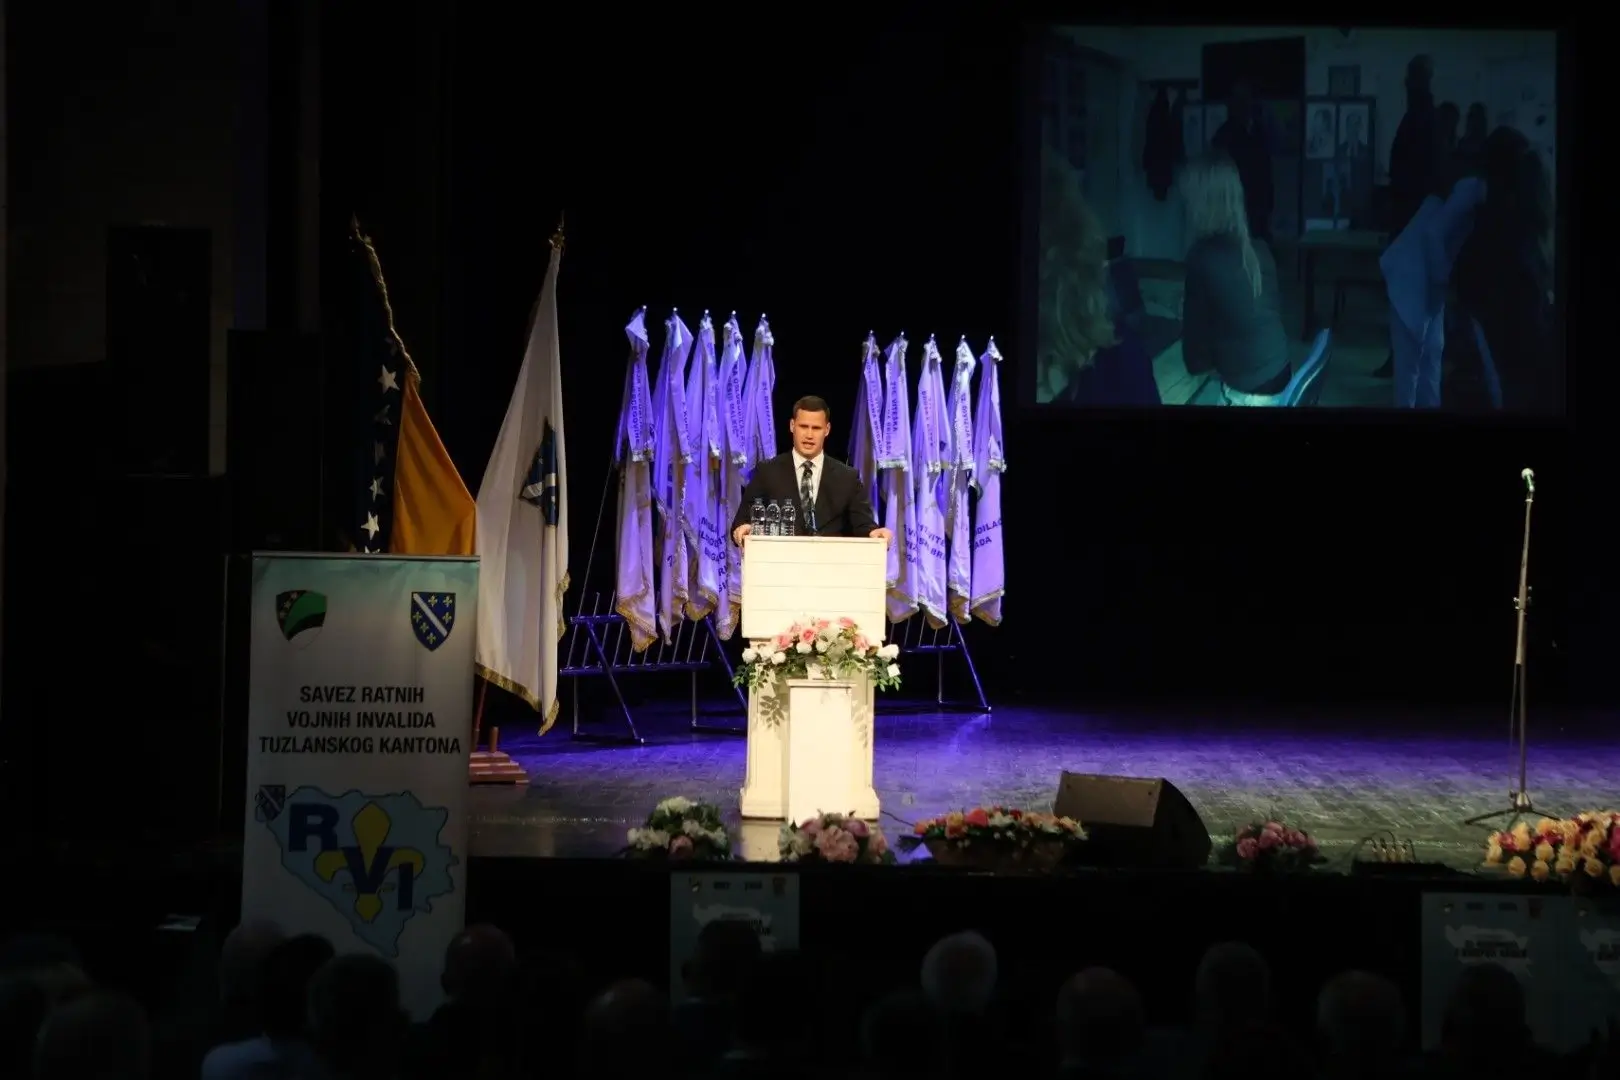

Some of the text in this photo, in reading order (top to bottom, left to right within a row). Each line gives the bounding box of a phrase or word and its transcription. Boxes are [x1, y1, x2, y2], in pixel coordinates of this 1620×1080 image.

[300, 686, 424, 704] SAVEZ RATNIH
[287, 711, 436, 729] VOJNIH INVALIDA
[259, 736, 461, 755] TUZLANSKOG KANTONA
